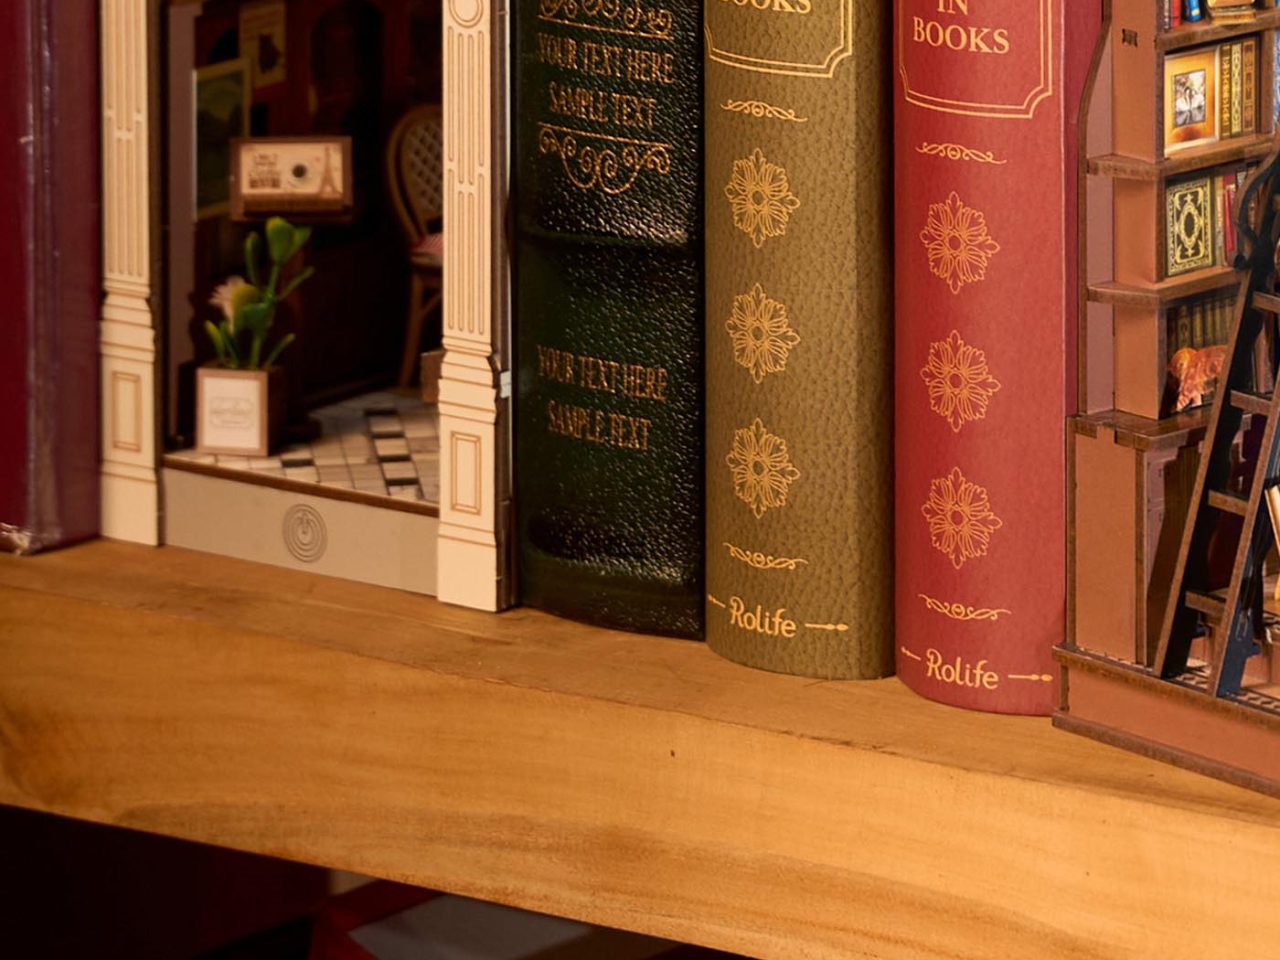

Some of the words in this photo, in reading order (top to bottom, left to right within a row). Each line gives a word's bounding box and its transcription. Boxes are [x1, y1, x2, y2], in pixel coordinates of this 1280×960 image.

[538, 32, 577, 70] YOUR
[582, 40, 623, 78] TEXT
[625, 46, 674, 84] HERE
[912, 14, 1010, 54] BOOKS
[549, 80, 608, 123] SAMPLE
[611, 91, 656, 129] TEXT
[537, 343, 575, 384] YOUR
[578, 354, 620, 394] TEXT
[622, 363, 668, 401] HERE
[547, 399, 606, 444] SAMPLE
[608, 410, 651, 451] TEXT
[730, 595, 798, 638] Rolife
[926, 648, 999, 690] Rolife
